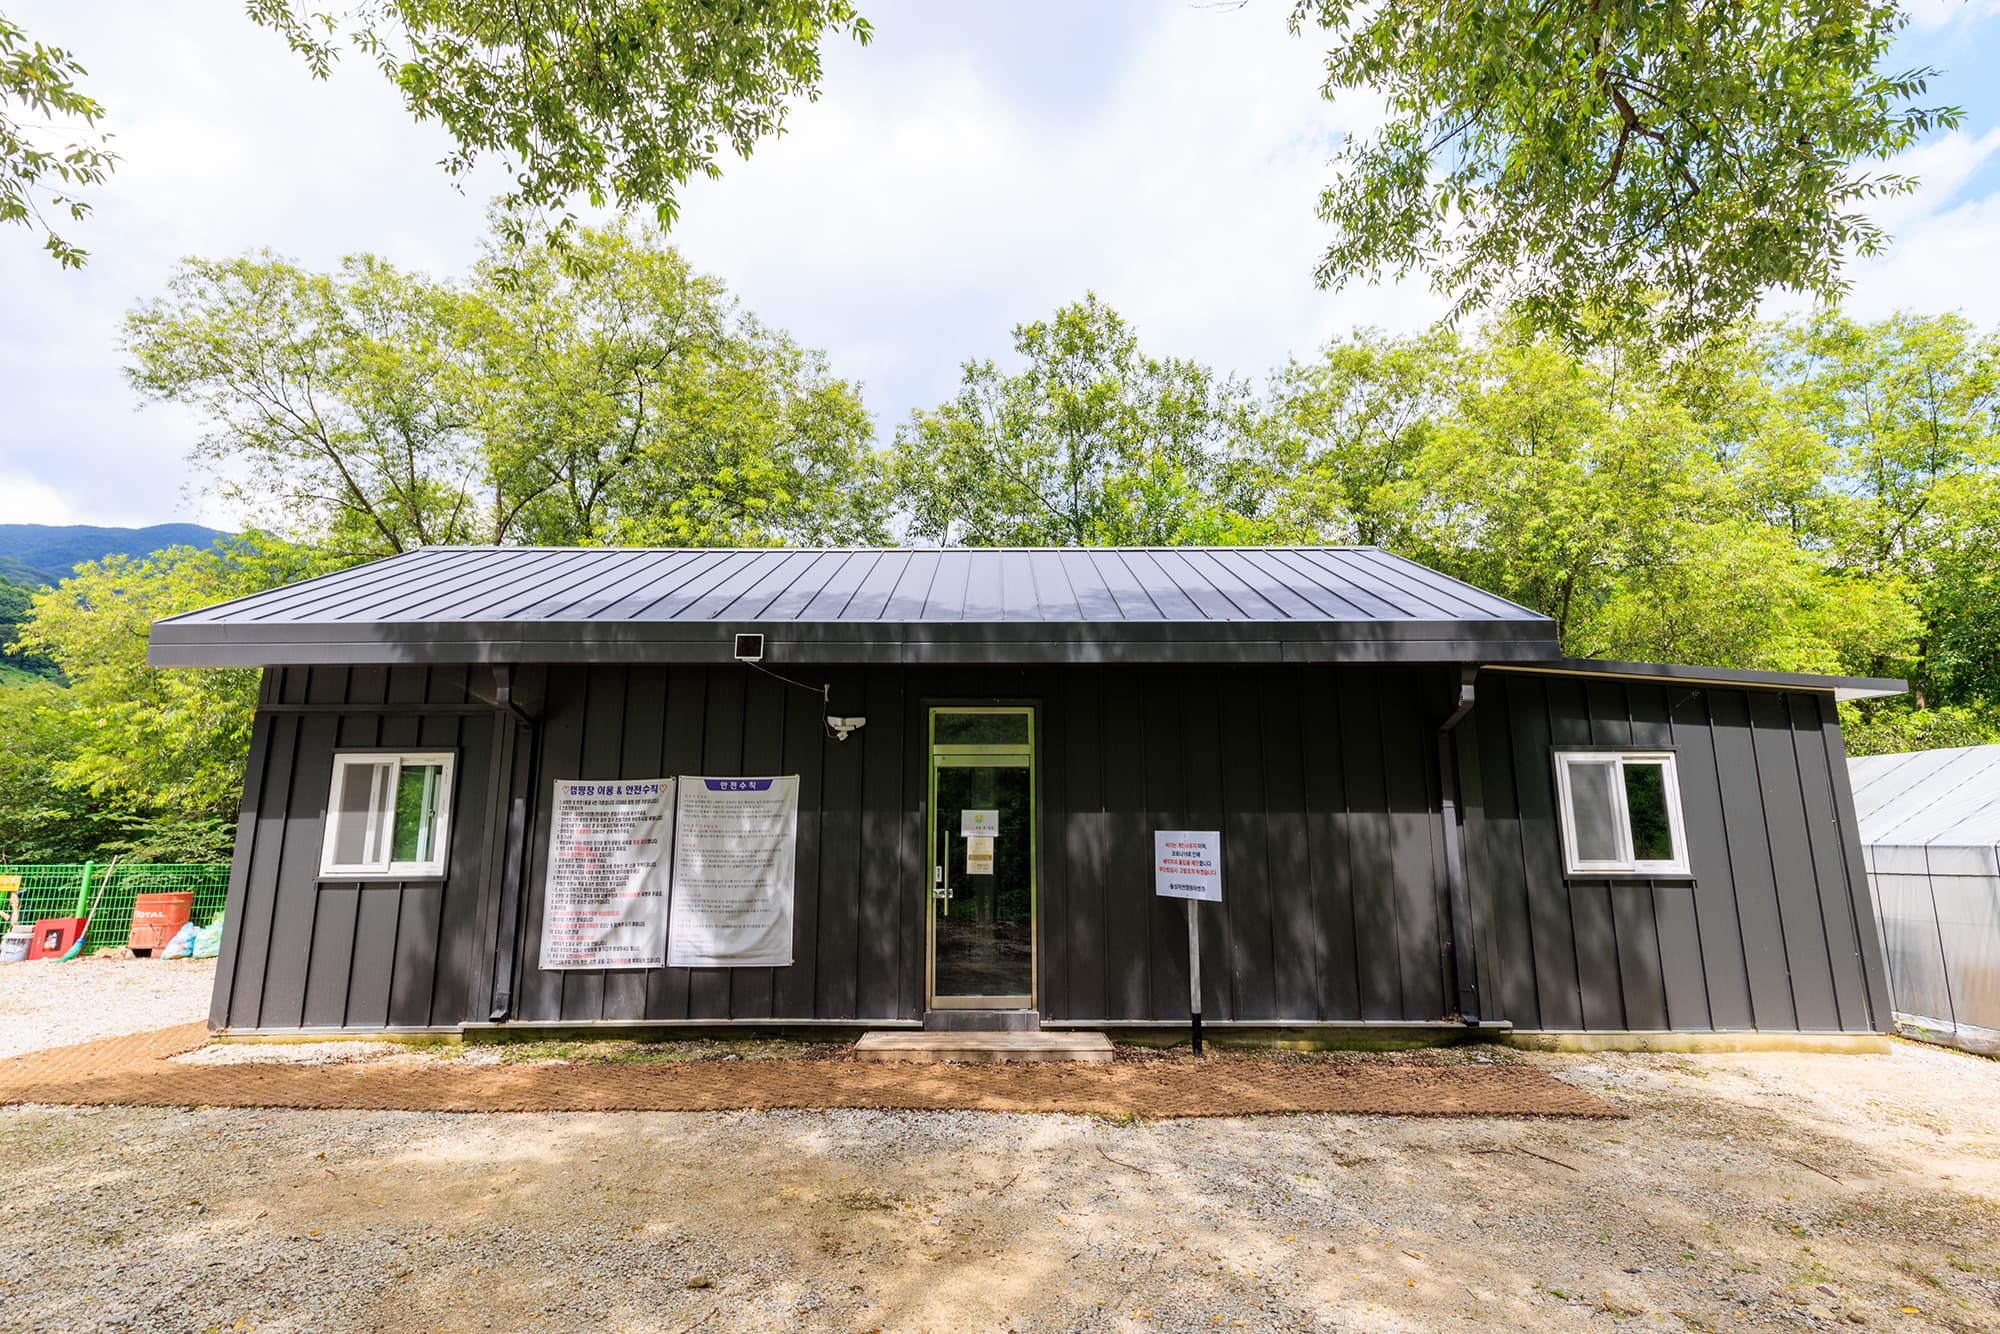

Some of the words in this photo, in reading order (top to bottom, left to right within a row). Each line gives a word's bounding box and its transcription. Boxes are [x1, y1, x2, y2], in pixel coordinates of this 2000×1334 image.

[570, 785, 595, 796] 캠핑장
[597, 785, 614, 796] 이용
[616, 785, 623, 795] &
[625, 784, 659, 796] 안전수칙
[719, 781, 757, 790] 안전수칙
[134, 910, 166, 919] TOTAL
